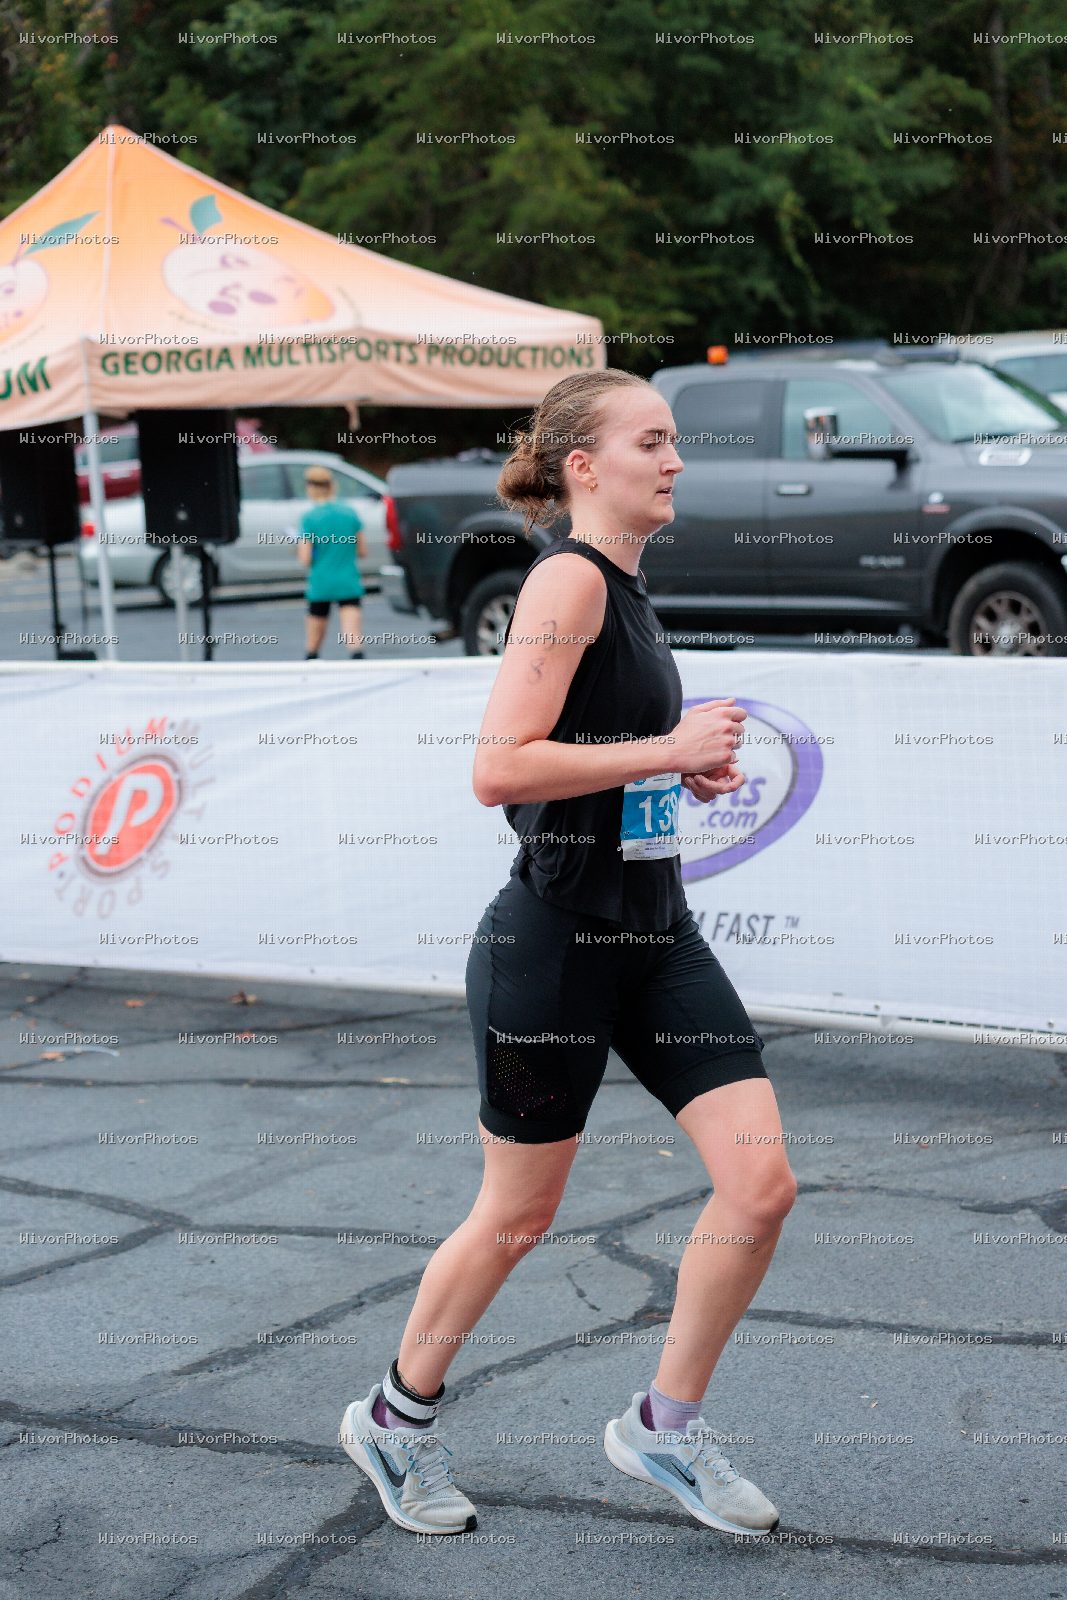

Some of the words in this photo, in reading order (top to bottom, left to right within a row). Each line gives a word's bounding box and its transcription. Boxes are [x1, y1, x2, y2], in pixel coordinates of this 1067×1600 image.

[100, 347, 236, 377] GEORGIA
[241, 336, 419, 368] MULTISPORTS
[426, 343, 595, 370] PRODUCTIONS
[48, 716, 169, 872] PODIUM
[95, 772, 165, 856] P
[700, 808, 759, 830] .com
